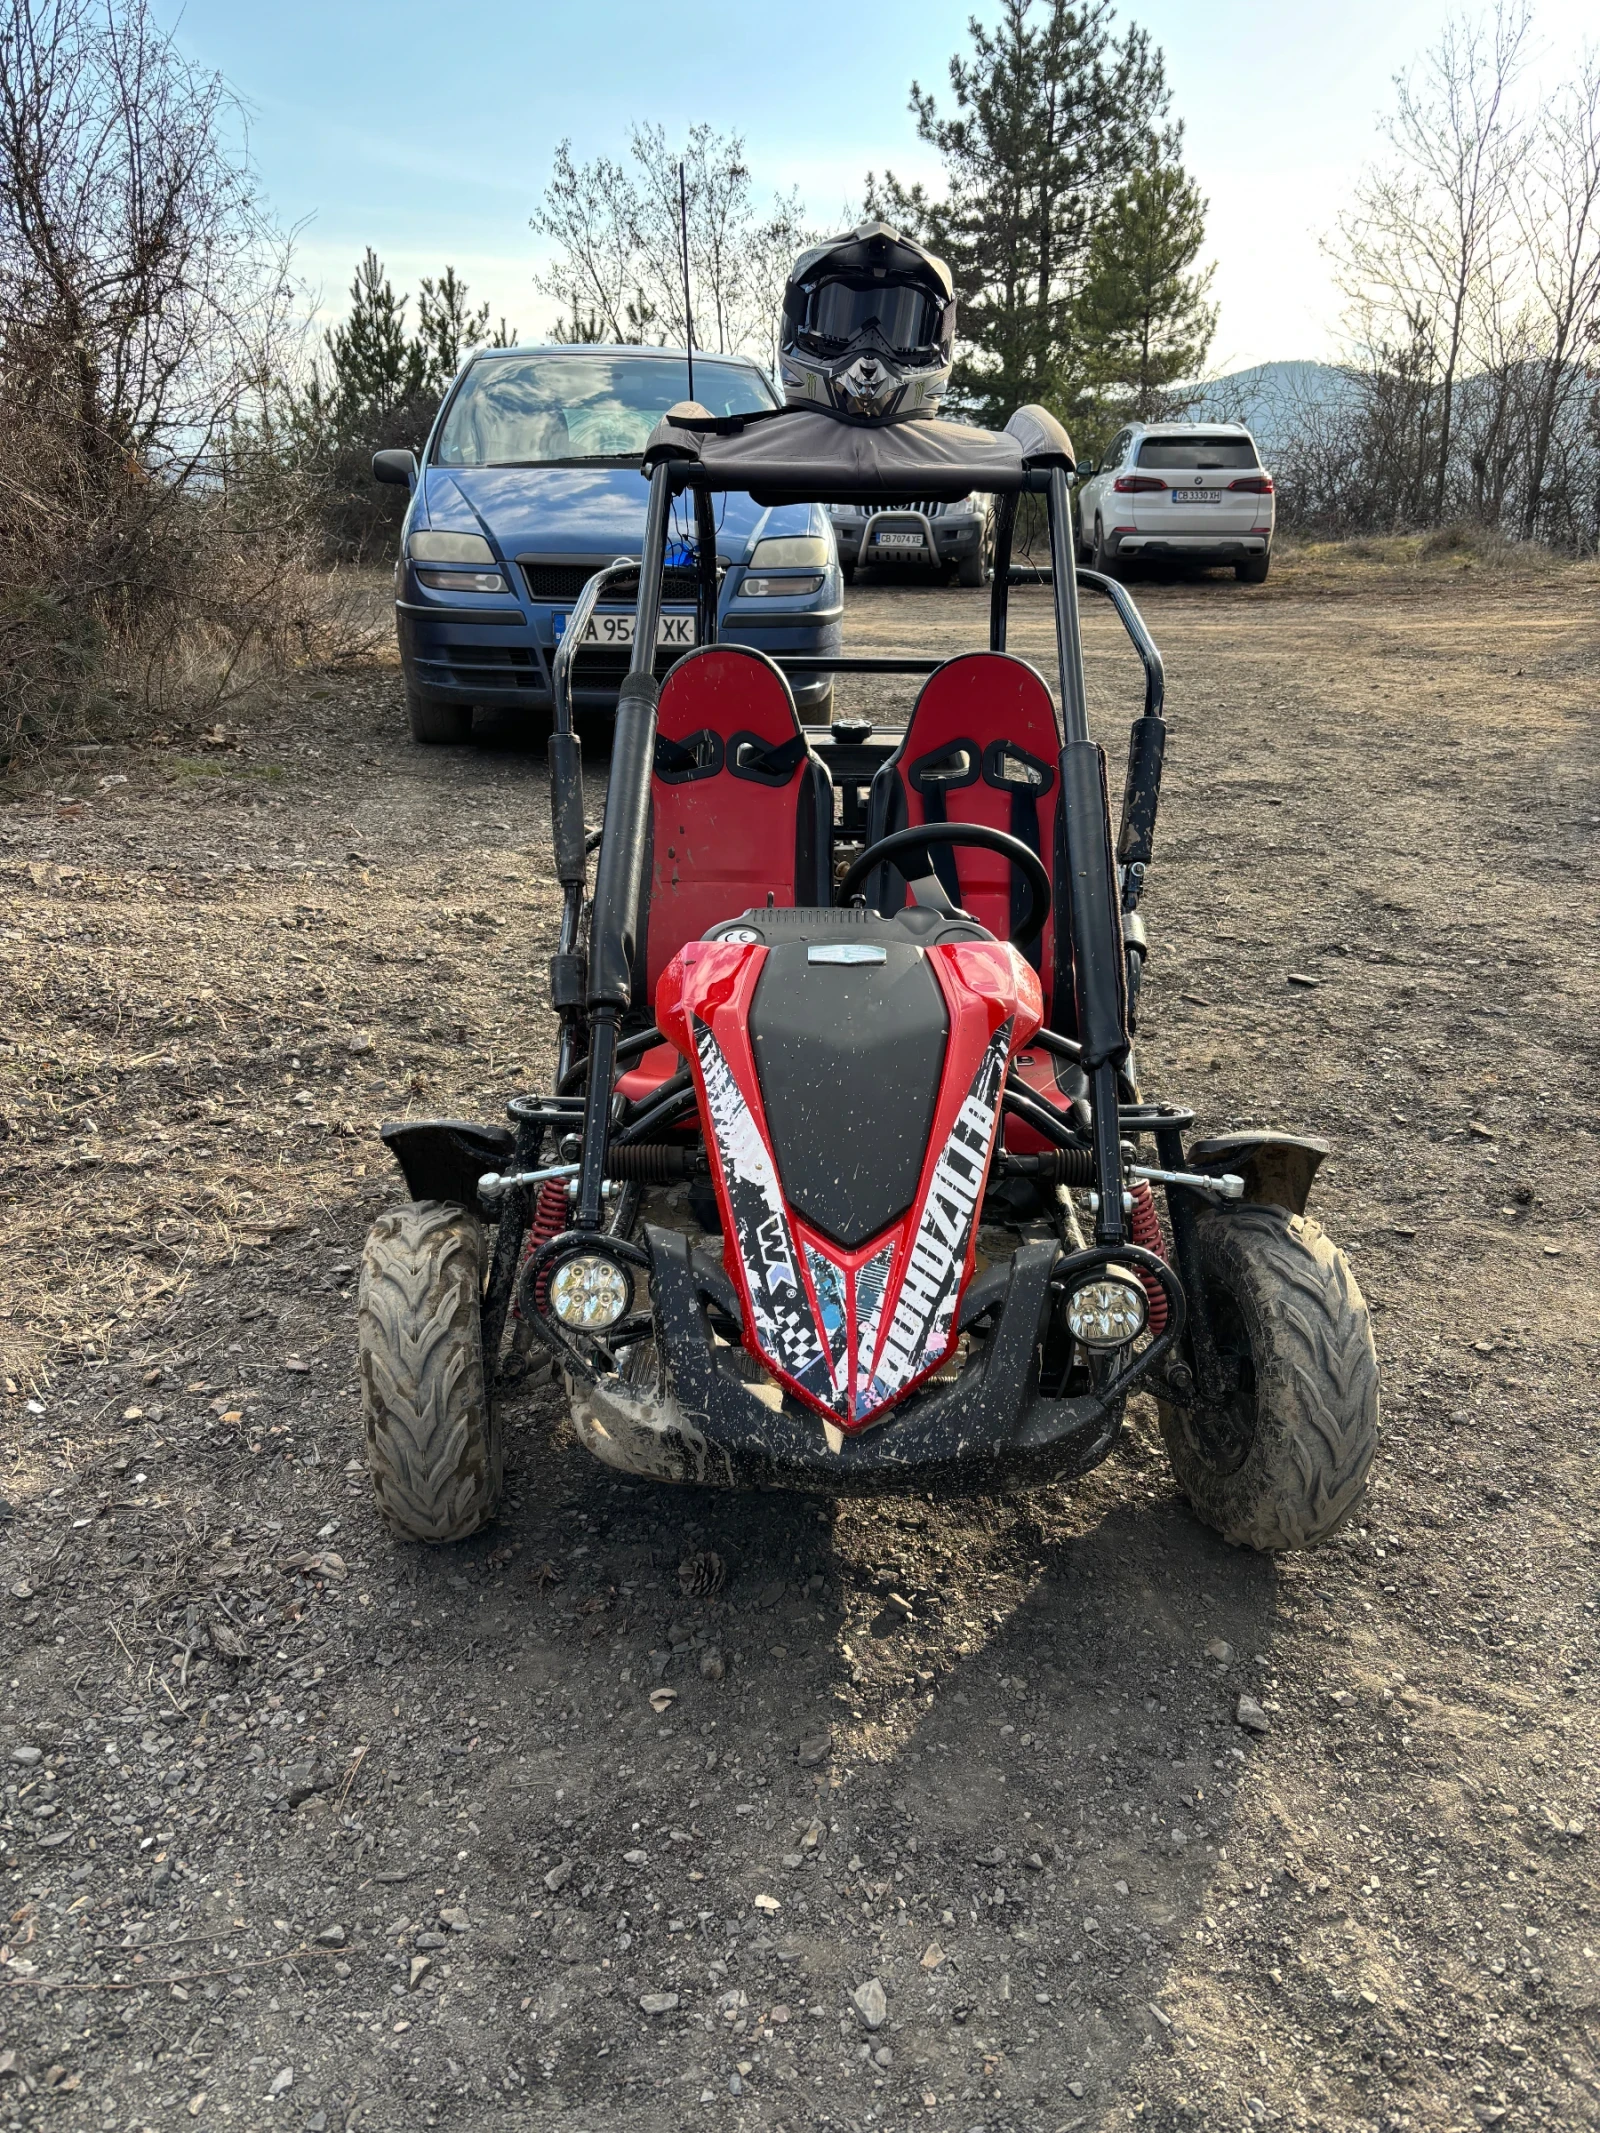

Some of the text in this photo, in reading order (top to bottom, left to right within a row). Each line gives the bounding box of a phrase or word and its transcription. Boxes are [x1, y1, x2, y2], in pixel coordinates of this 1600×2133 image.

[1178, 491, 1220, 500] CB 3330 XH
[881, 534, 922, 544] CB 7074 XE
[662, 619, 690, 642] XK
[724, 931, 750, 943] CE
